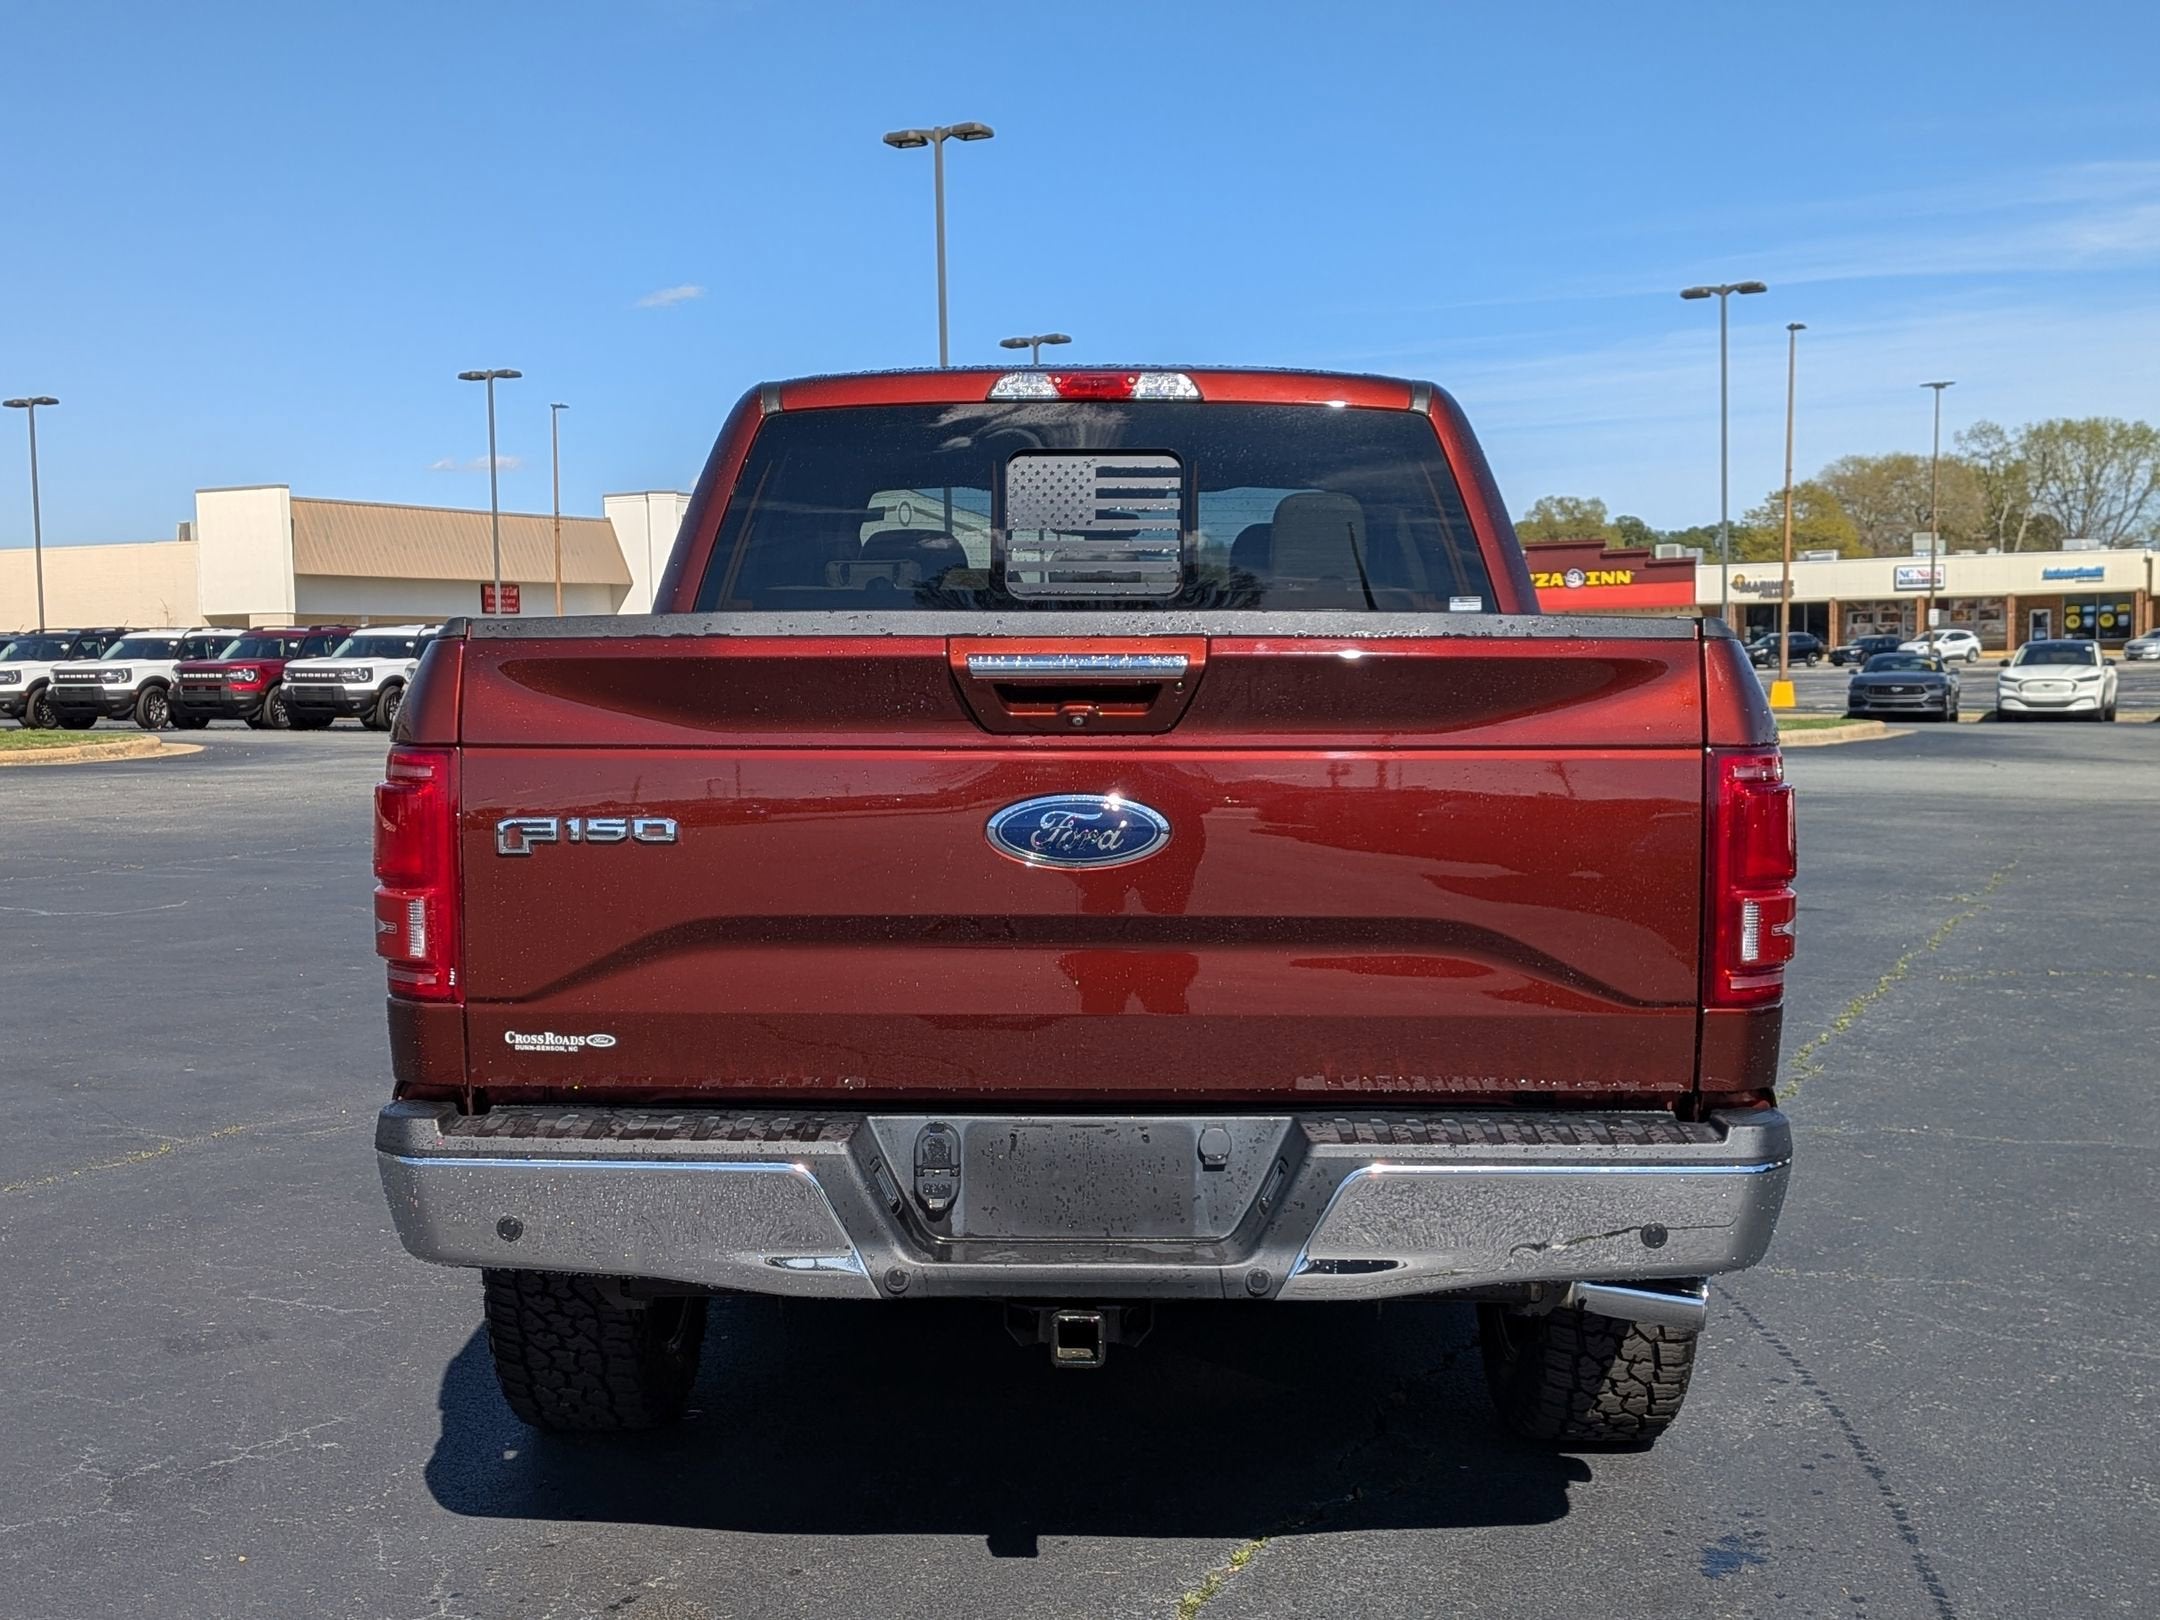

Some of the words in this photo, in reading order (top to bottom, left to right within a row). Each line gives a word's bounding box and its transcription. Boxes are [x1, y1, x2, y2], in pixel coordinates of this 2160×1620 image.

[1530, 572, 1564, 587] ZA
[1585, 570, 1631, 585] INN
[1030, 810, 1128, 851] Ford
